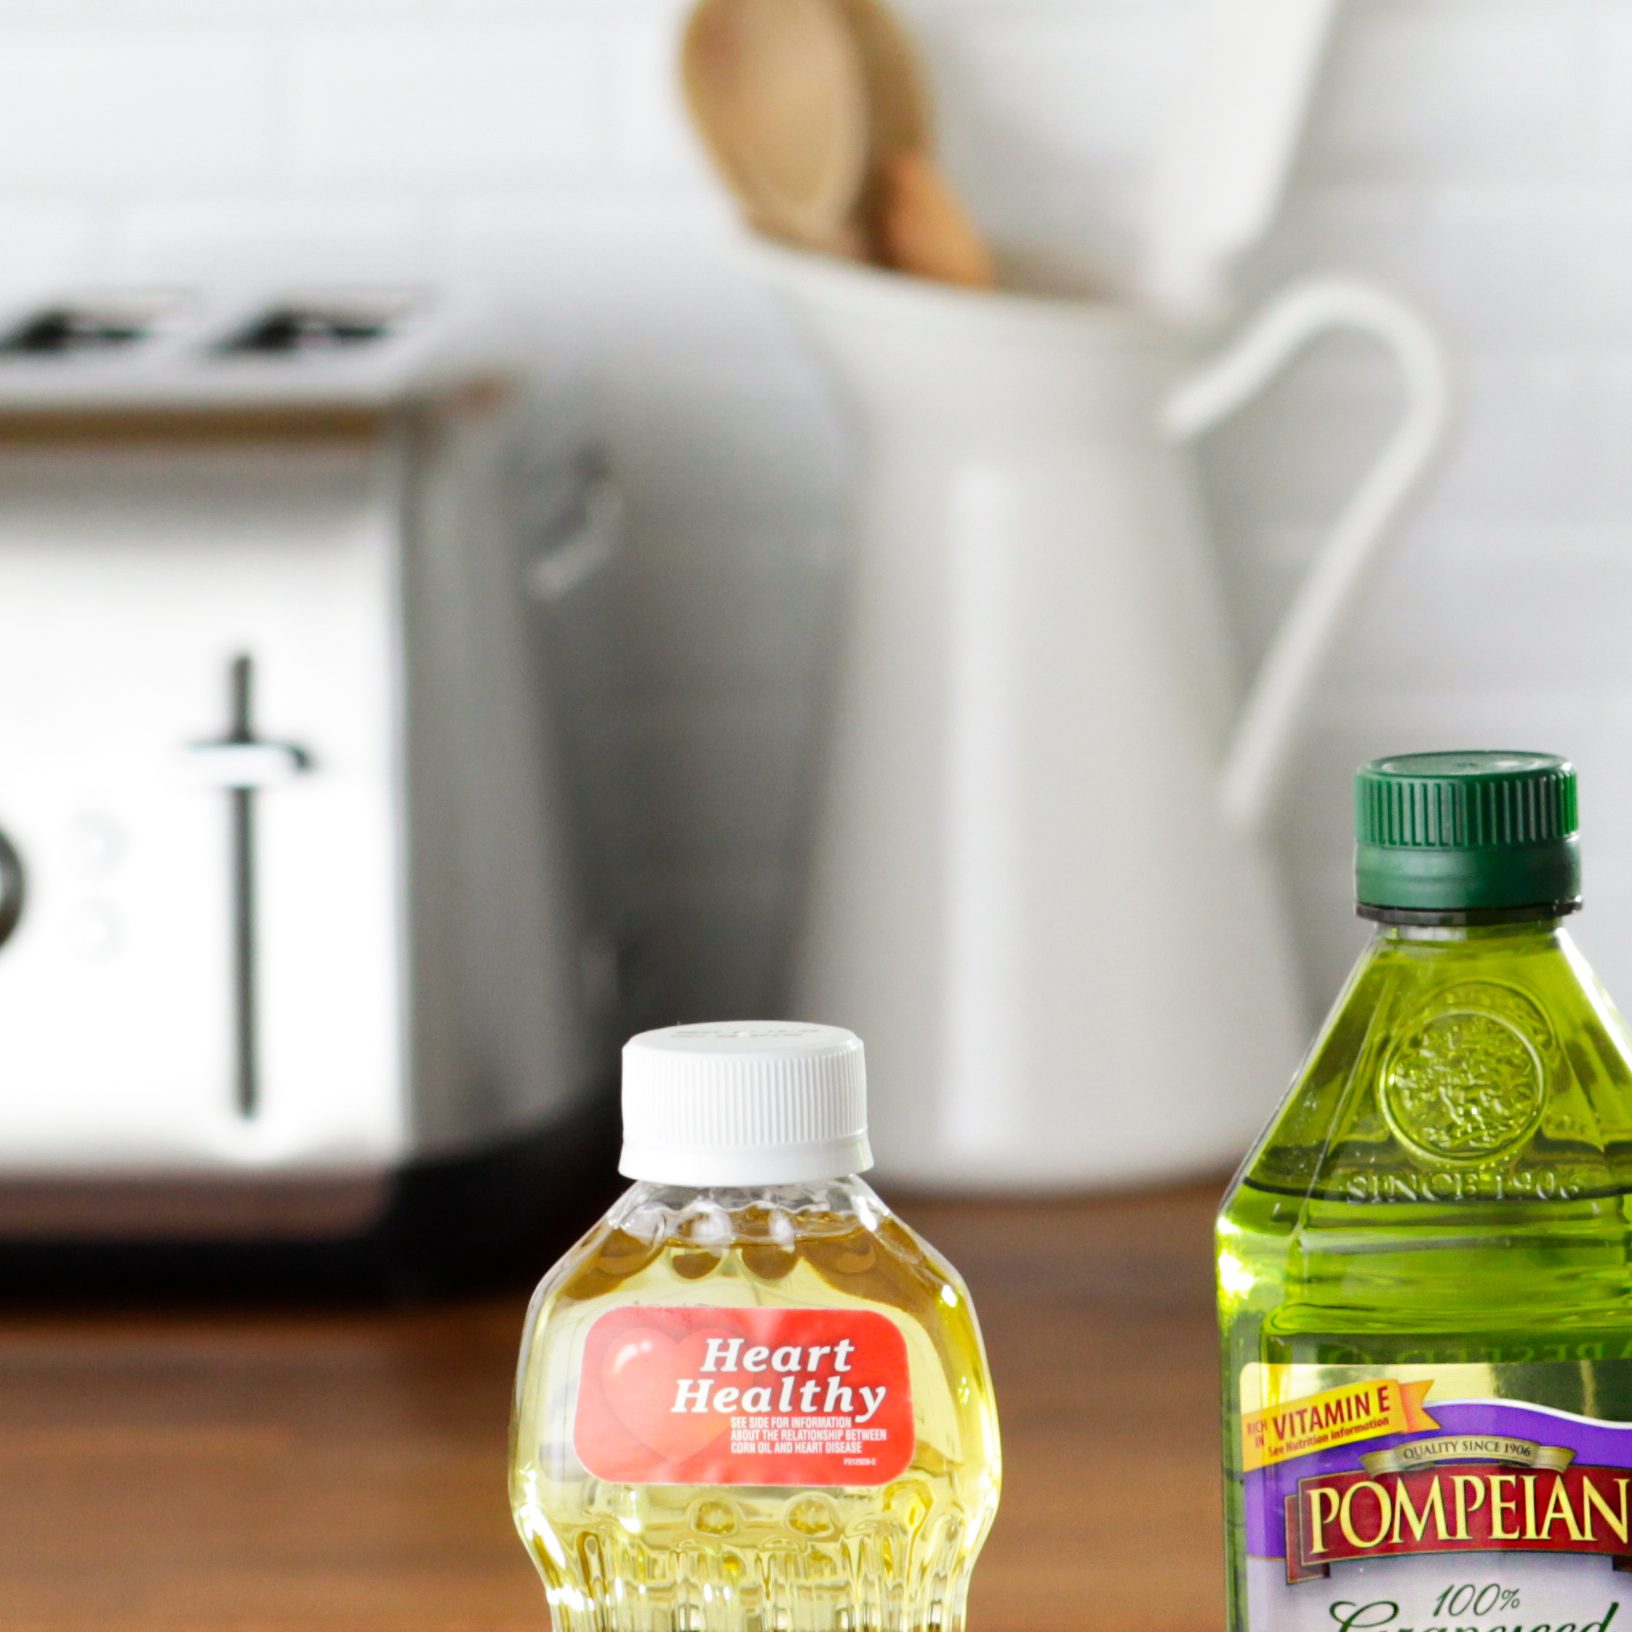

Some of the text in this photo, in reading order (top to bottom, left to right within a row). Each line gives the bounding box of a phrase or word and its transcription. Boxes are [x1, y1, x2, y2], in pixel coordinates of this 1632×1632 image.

[700, 1337, 855, 1373] Heart
[670, 1375, 887, 1424] Healthy
[1272, 1385, 1392, 1441] VITAMIN E
[731, 1416, 852, 1429] SEE SIDE FOR INFORMATION
[731, 1429, 887, 1441] ABOUT THE RELATIONSHIP BETWEEN
[1403, 1440, 1532, 1460] QUALITY SINCE 1906
[1305, 1474, 1632, 1555] POMPEIAN
[1432, 1582, 1521, 1618] 100%
